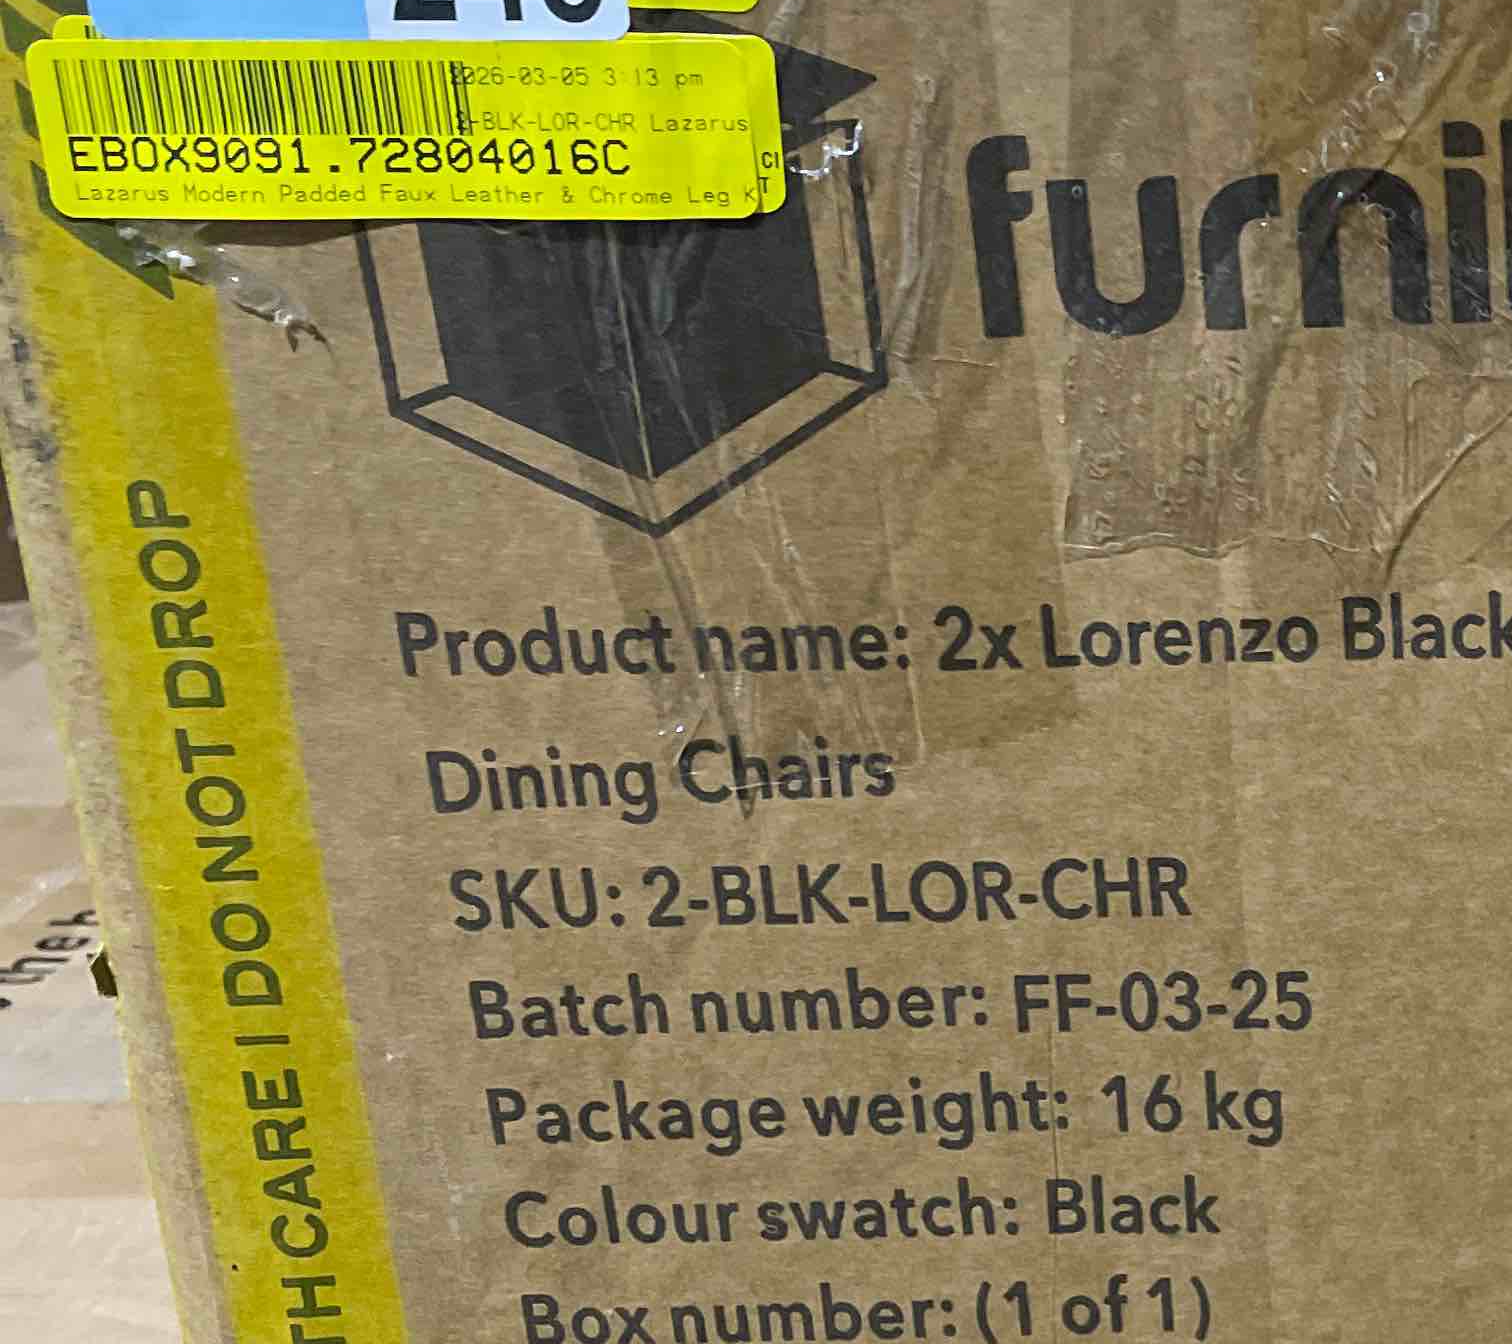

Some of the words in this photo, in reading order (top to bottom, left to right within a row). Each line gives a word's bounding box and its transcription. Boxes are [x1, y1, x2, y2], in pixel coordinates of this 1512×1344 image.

[676, 72, 703, 89] pm
[68, 135, 632, 177] EBOX9091.72804016C
[651, 113, 749, 132] Lazarus
[75, 184, 170, 204] Lazarus
[183, 184, 266, 204] Modern
[279, 184, 364, 204] Padded
[379, 184, 437, 205] Faux
[451, 185, 551, 205] Leather
[561, 187, 574, 205] &
[589, 185, 672, 206] Chrome
[688, 185, 738, 210] Leg
[127, 478, 228, 710] DROP
[395, 605, 674, 677] Product
[697, 616, 911, 673] name:
[932, 604, 1022, 672] 2x
[1040, 603, 1319, 668] Lorenzo
[175, 728, 261, 884] NOT
[425, 746, 658, 825] Dining
[677, 738, 896, 805] Chairs
[448, 866, 626, 933] SKU:
[645, 856, 1193, 928] 2-BLK-LOR-CHR
[210, 902, 284, 1009] DO
[468, 973, 670, 1040] Batch
[690, 967, 988, 1035] number:
[1012, 969, 1313, 1033] FF-03-25
[485, 1080, 786, 1156] Package
[801, 1075, 1070, 1150] weight:
[1100, 1074, 1183, 1134] 16
[1202, 1071, 1286, 1147] kg
[244, 1067, 330, 1259] CARE
[503, 1184, 740, 1249] Colour
[758, 1176, 1020, 1240] swatch:
[1045, 1175, 1221, 1237] Black
[672, 1281, 958, 1344] number:
[1060, 1274, 1129, 1337] of
[1148, 1275, 1214, 1342] 1)
